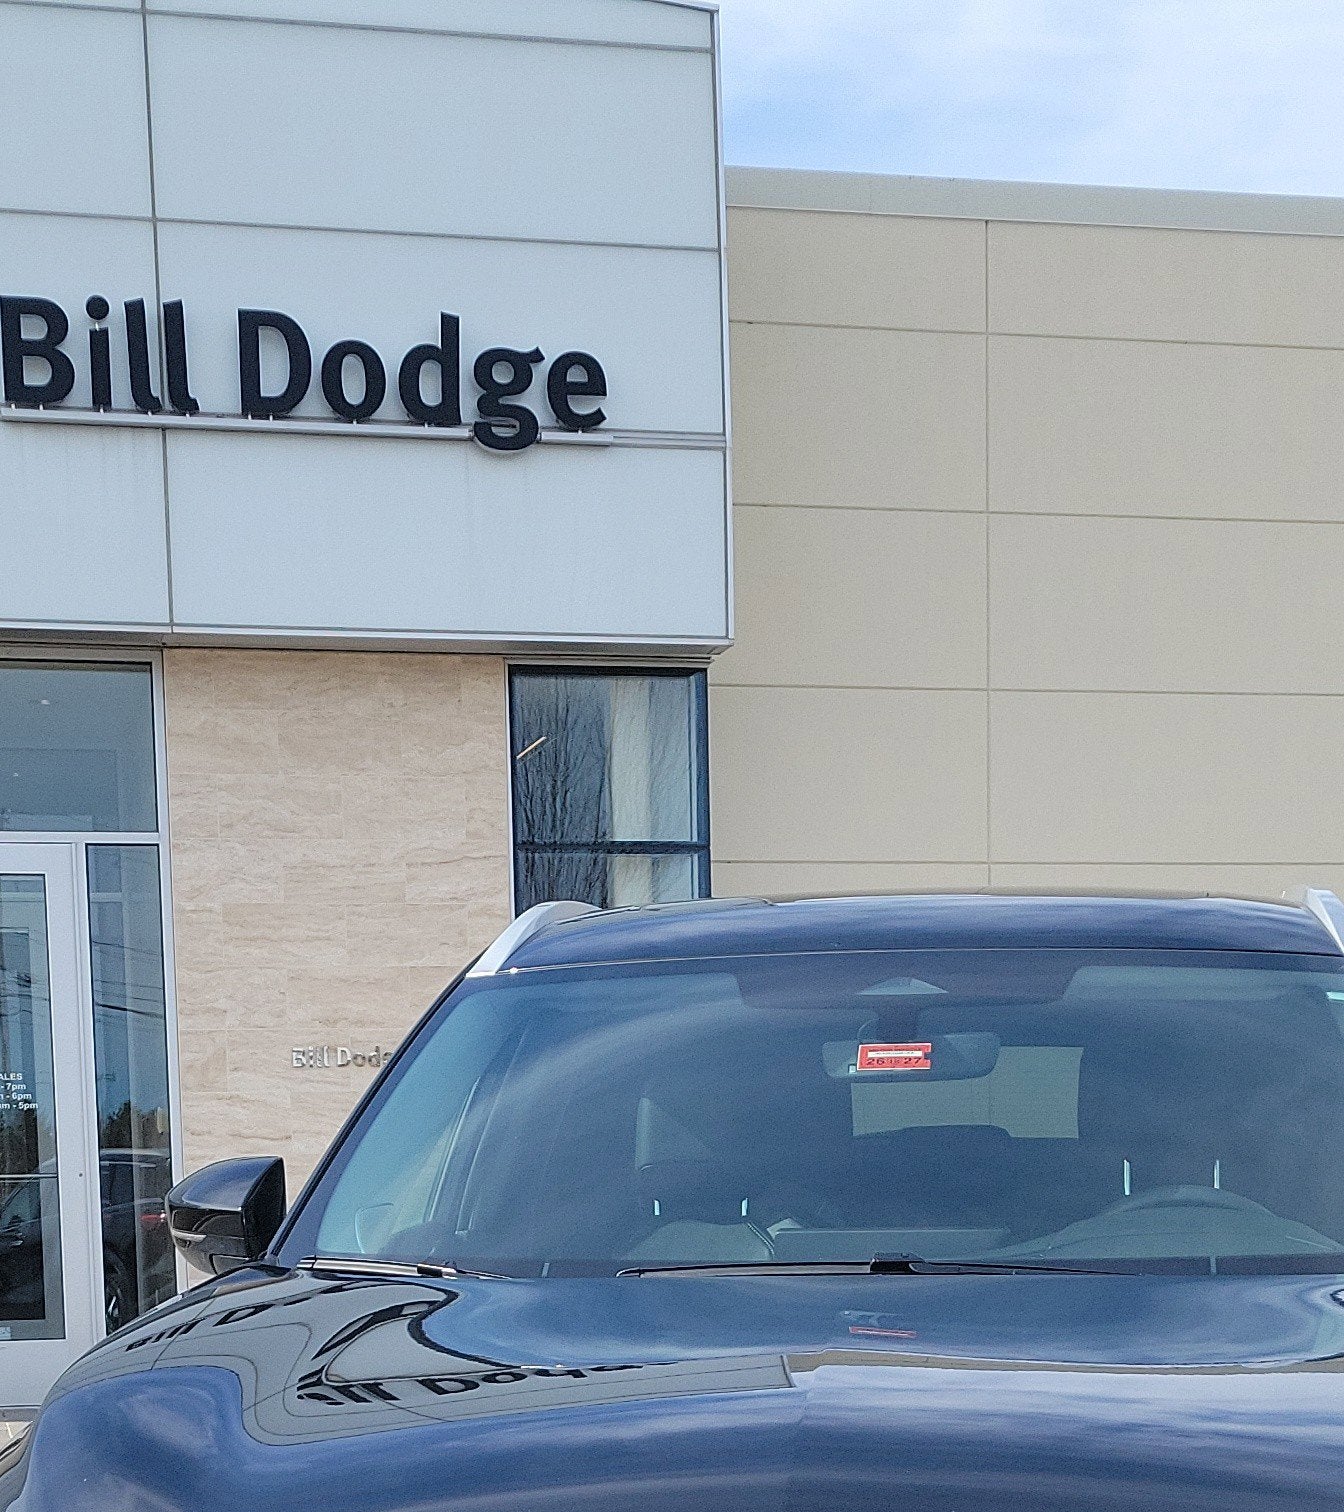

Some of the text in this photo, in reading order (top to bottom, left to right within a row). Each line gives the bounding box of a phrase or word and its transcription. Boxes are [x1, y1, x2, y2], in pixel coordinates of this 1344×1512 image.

[0, 294, 608, 451] Bill Dodge
[292, 1046, 394, 1068] Bill Dod
[6, 1083, 27, 1092] 7pm
[18, 1102, 39, 1111] 5pm
